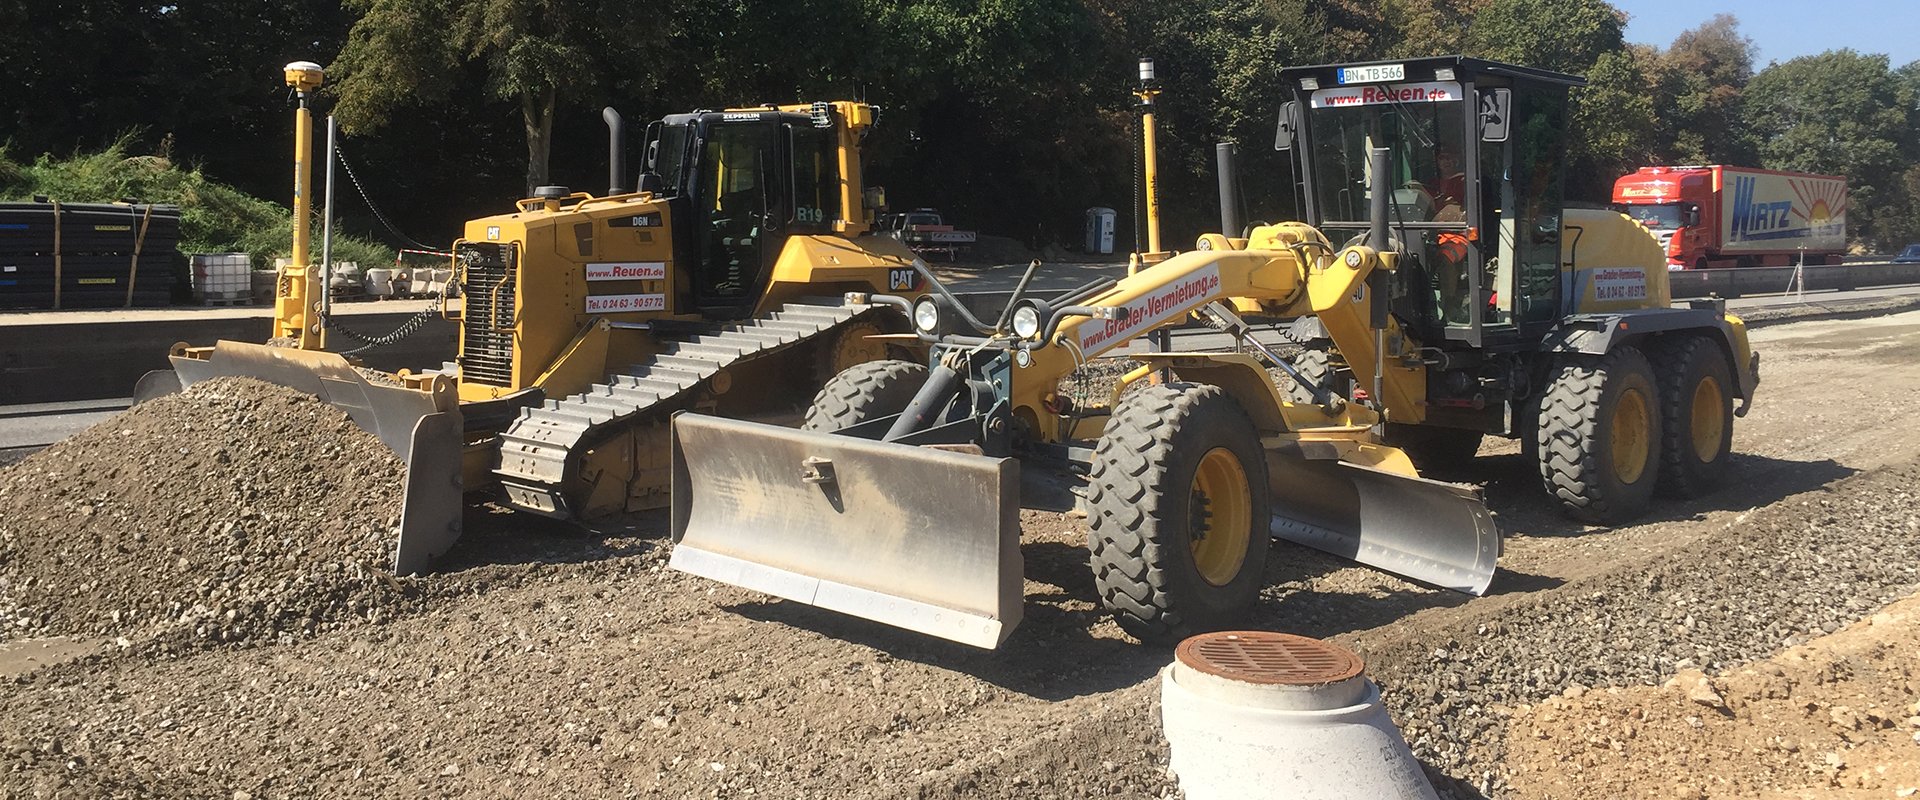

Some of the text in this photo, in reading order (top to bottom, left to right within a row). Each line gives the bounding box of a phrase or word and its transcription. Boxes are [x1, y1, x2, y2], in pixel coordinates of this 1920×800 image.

[1345, 67, 1402, 81] BN TB 566
[1325, 87, 1446, 105] www.Reuen.de
[797, 207, 823, 222] R19
[1731, 176, 1792, 242] WIRTZ
[632, 216, 648, 226] D6N
[588, 266, 664, 278] www.Reuen.de
[890, 270, 914, 290] CAT
[588, 300, 600, 309] Tel.
[602, 300, 608, 308] 0
[608, 300, 618, 308] 24
[620, 300, 628, 308] 63
[634, 298, 643, 308] 90
[644, 298, 654, 307] 57
[654, 298, 663, 306] 72
[1083, 275, 1219, 349] www.Grader-Vermietung.de
